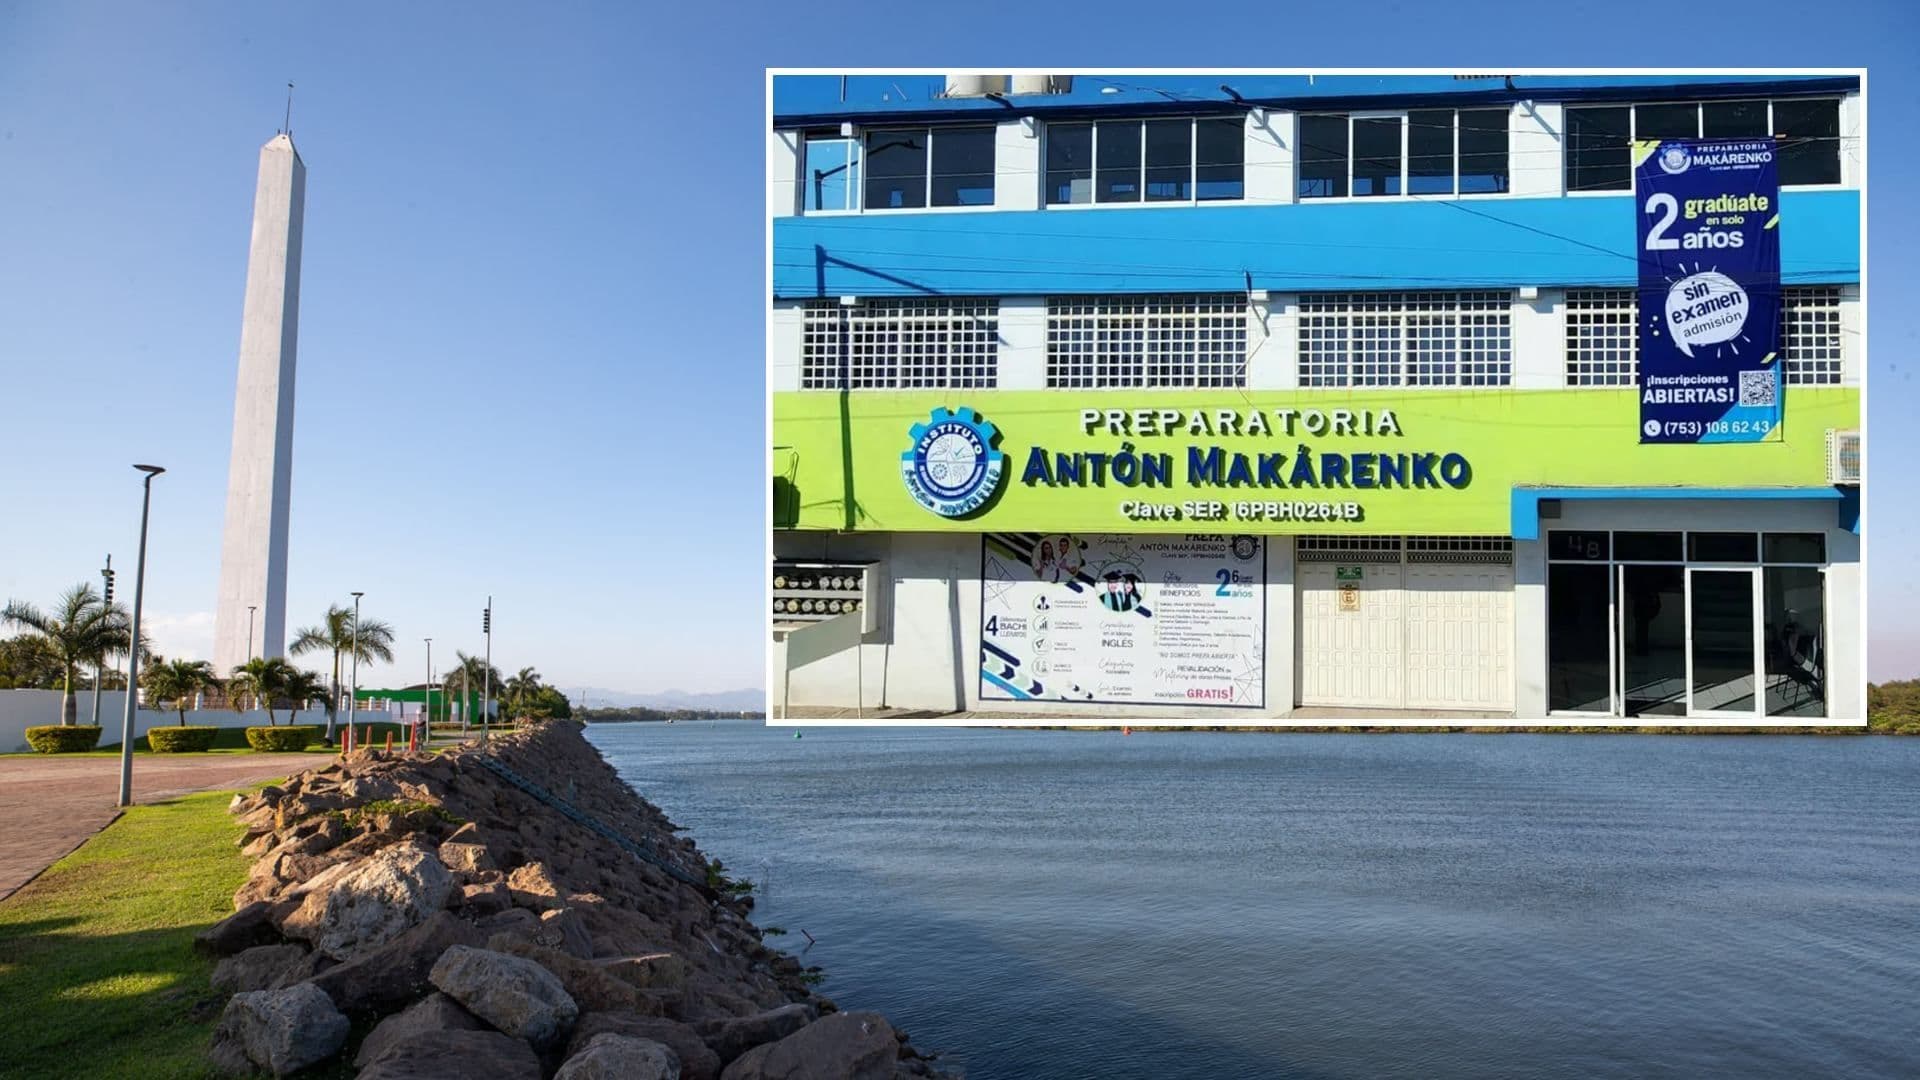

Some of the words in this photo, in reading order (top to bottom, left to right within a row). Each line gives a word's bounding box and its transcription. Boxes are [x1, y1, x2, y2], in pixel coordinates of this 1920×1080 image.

[1697, 143, 1768, 153] PREPARATORIA
[1693, 152, 1772, 166] MAKÁRENKO
[1684, 193, 1769, 219] gradúate
[1645, 193, 1680, 250] 2
[1705, 217, 1720, 225] en
[1721, 215, 1745, 225] solo
[1683, 226, 1744, 249] años
[1683, 280, 1710, 301] sin
[1671, 291, 1742, 324] examen
[1683, 311, 1743, 338] admisión
[1647, 375, 1729, 387] ¡Inscripciones
[1642, 388, 1735, 404] ABIERTAS!
[1080, 408, 1400, 435] PREPARATORIA
[1664, 421, 1702, 436] (753)
[1705, 421, 1729, 434] 108
[1732, 421, 1749, 434] 62
[1752, 420, 1770, 433] 43
[917, 423, 983, 455] INSTITUTO
[1021, 442, 1168, 486] ANTÓN
[1120, 500, 1176, 518] Clave
[1182, 500, 1222, 518] SEP.
[1231, 501, 1360, 519] 16PBH0264B
[1215, 568, 1231, 597] 2
[1231, 569, 1240, 583] 6
[985, 615, 999, 636] 4
[1187, 686, 1234, 703] GRATIS!
